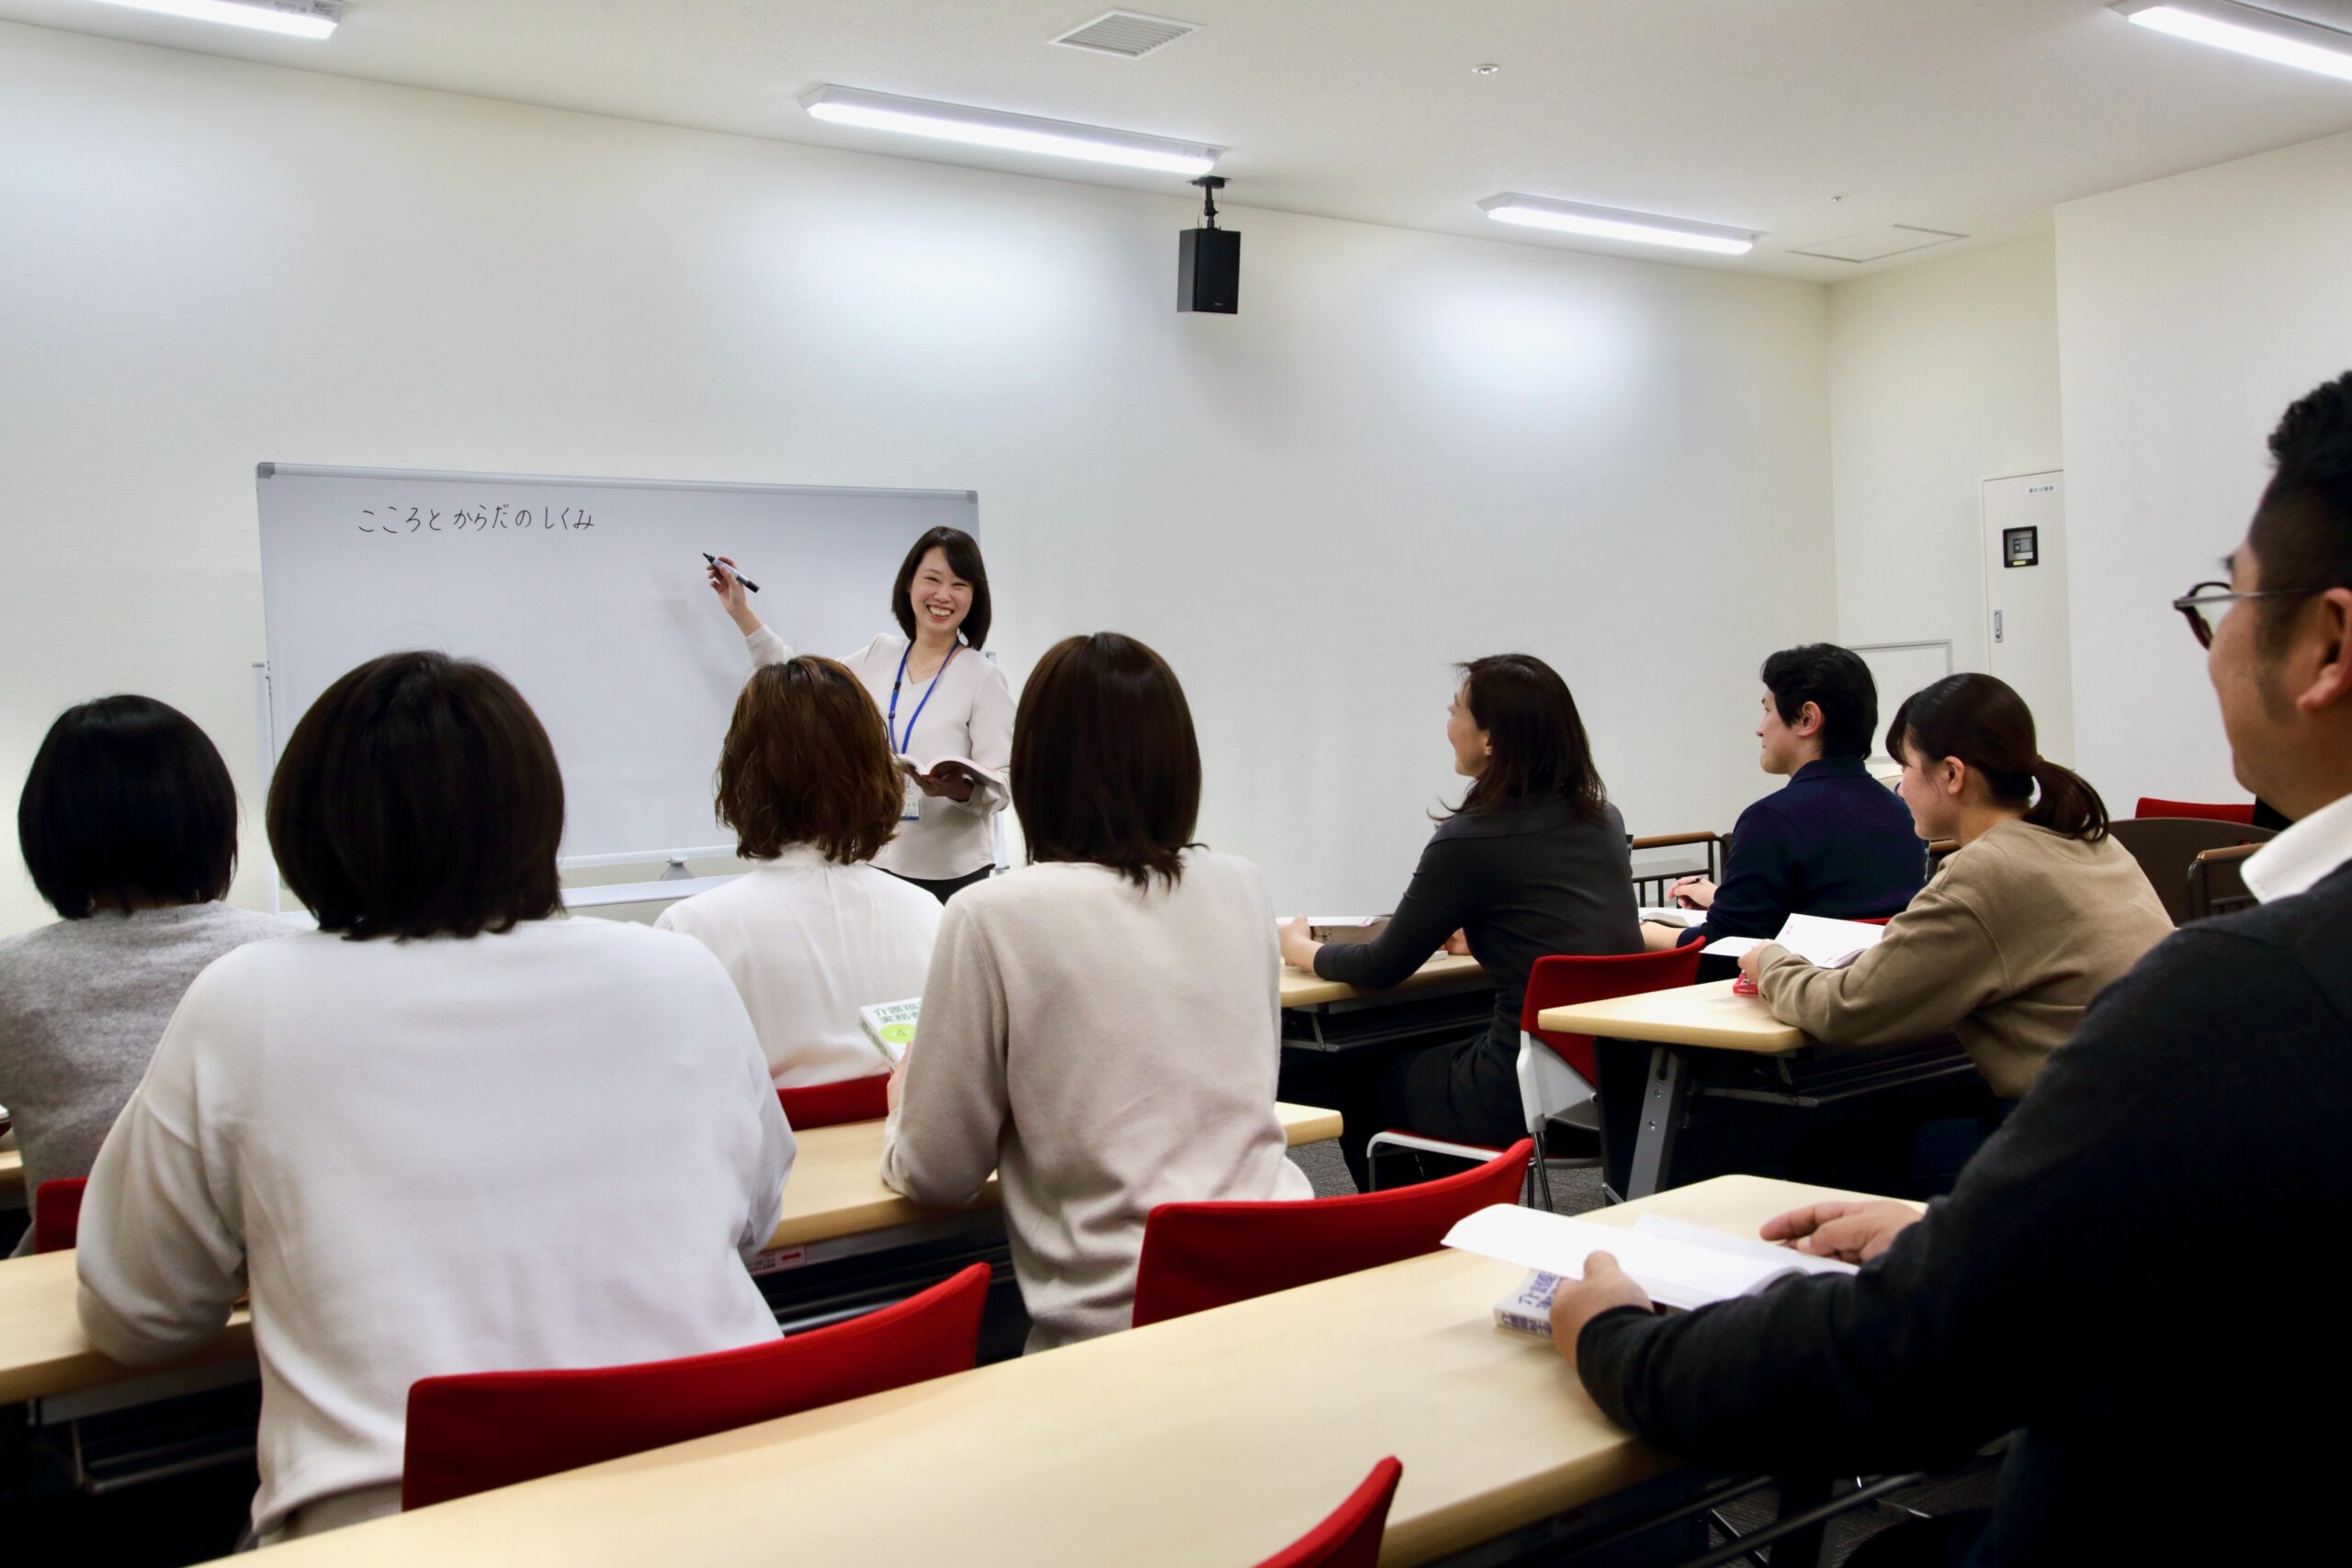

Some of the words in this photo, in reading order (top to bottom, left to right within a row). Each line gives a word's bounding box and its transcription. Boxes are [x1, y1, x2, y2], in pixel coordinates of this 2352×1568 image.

[358, 503, 595, 534] こころとからだのしくみ
